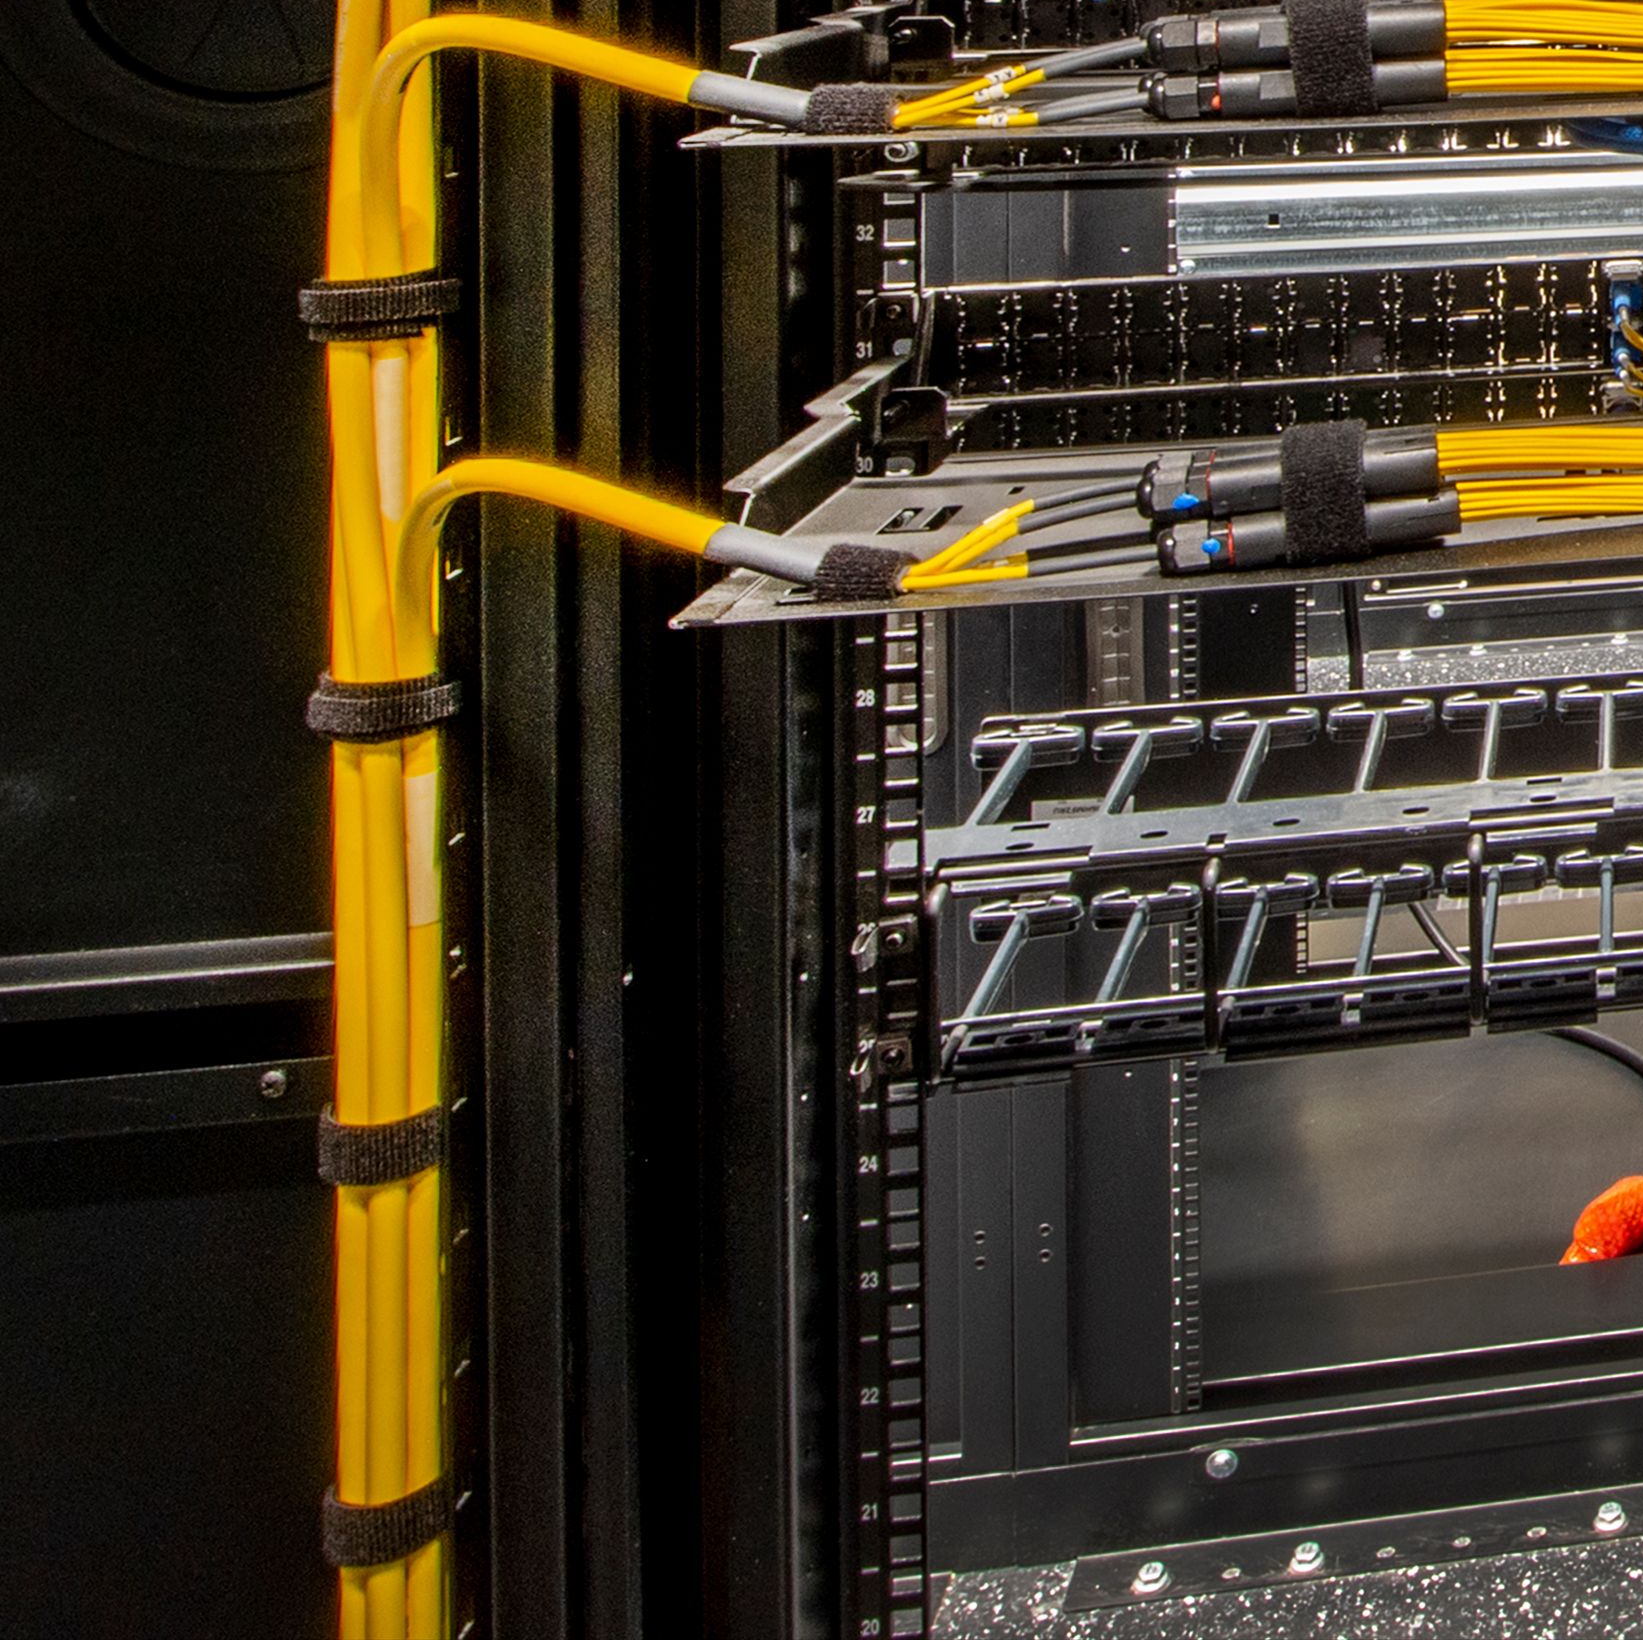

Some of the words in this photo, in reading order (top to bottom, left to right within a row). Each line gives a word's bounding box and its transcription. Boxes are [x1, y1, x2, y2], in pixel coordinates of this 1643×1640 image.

[856, 224, 874, 241] 32
[855, 342, 873, 358] 31
[856, 456, 874, 473] 30
[856, 688, 875, 708] 28
[856, 805, 876, 824] 27
[858, 1155, 878, 1174] 24
[860, 1271, 879, 1290] 23
[861, 1387, 880, 1406] 22
[861, 1502, 878, 1522] 21
[861, 1618, 880, 1637] 20
